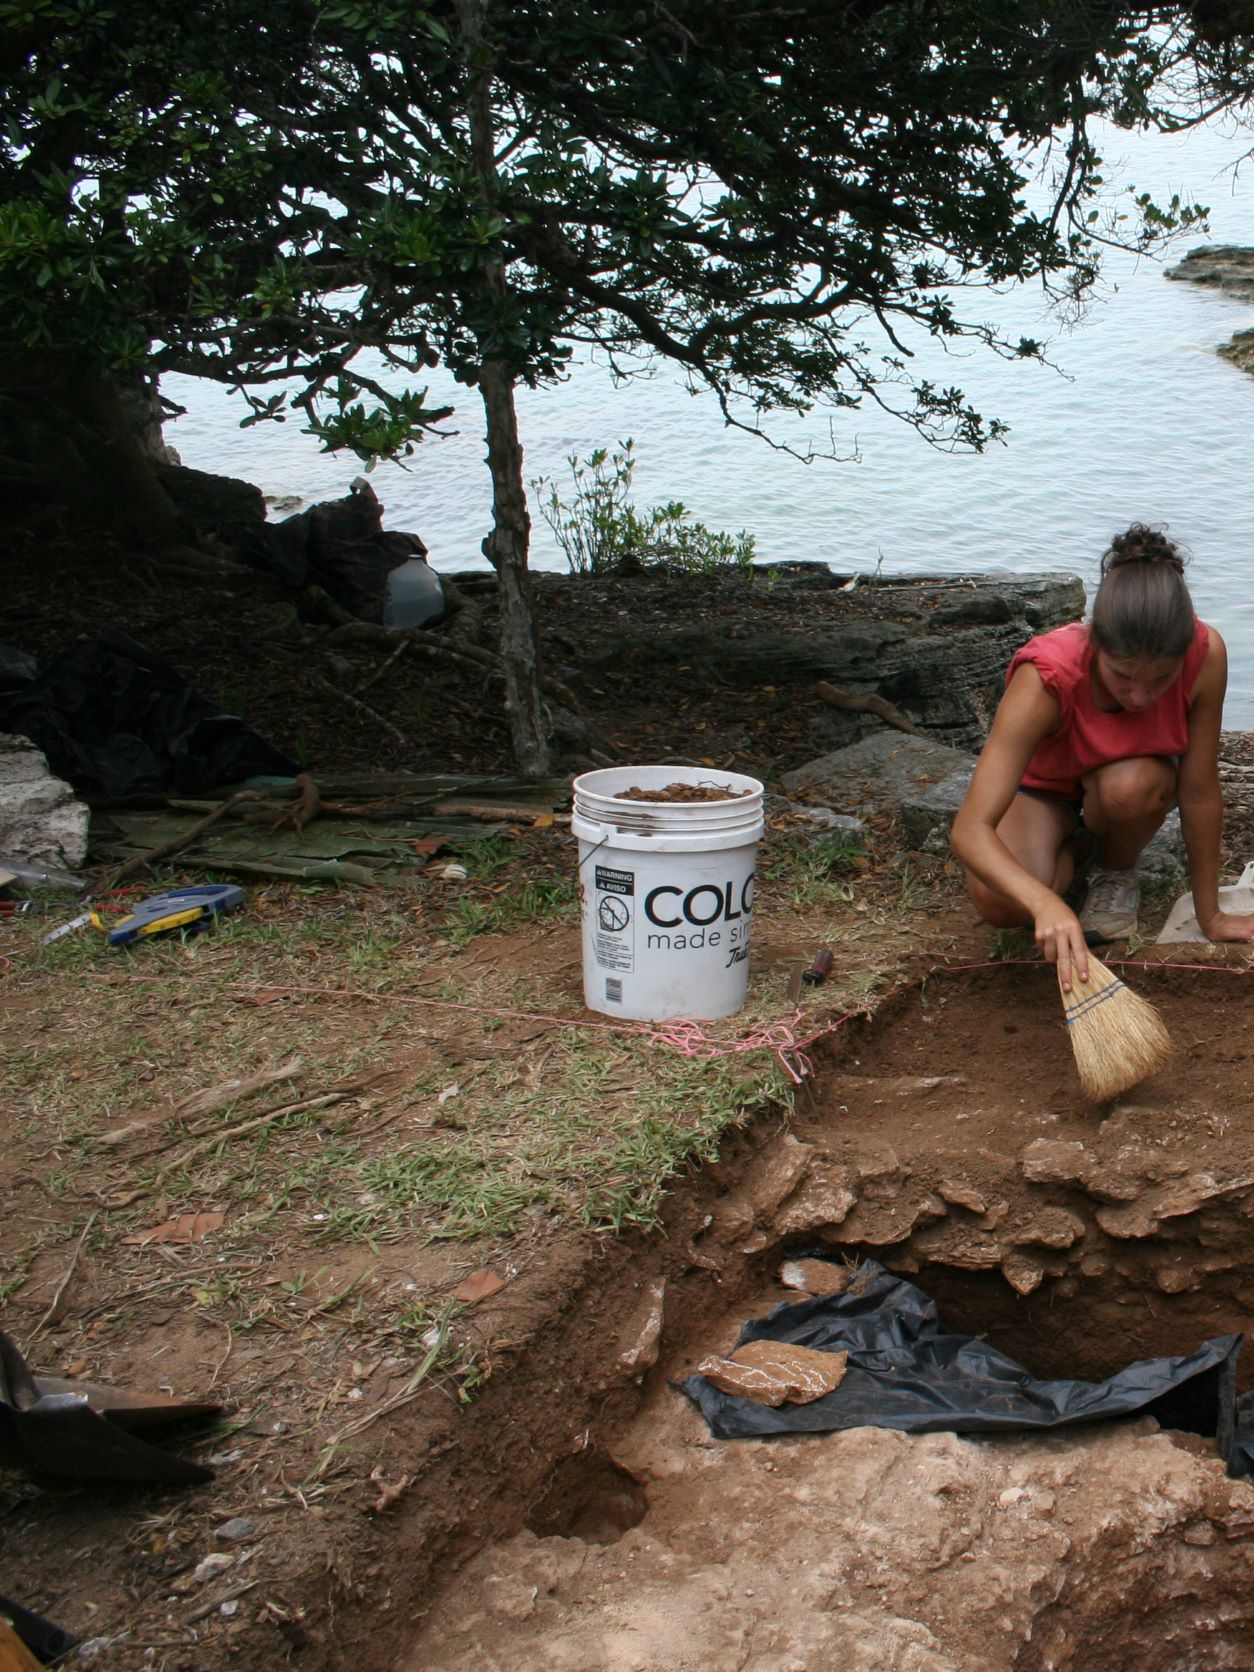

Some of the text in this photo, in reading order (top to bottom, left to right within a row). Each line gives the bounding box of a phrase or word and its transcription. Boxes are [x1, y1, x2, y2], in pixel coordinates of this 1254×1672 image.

[600, 870, 632, 882] WARNING
[606, 882, 626, 893] AVISO
[647, 927, 720, 950] made
